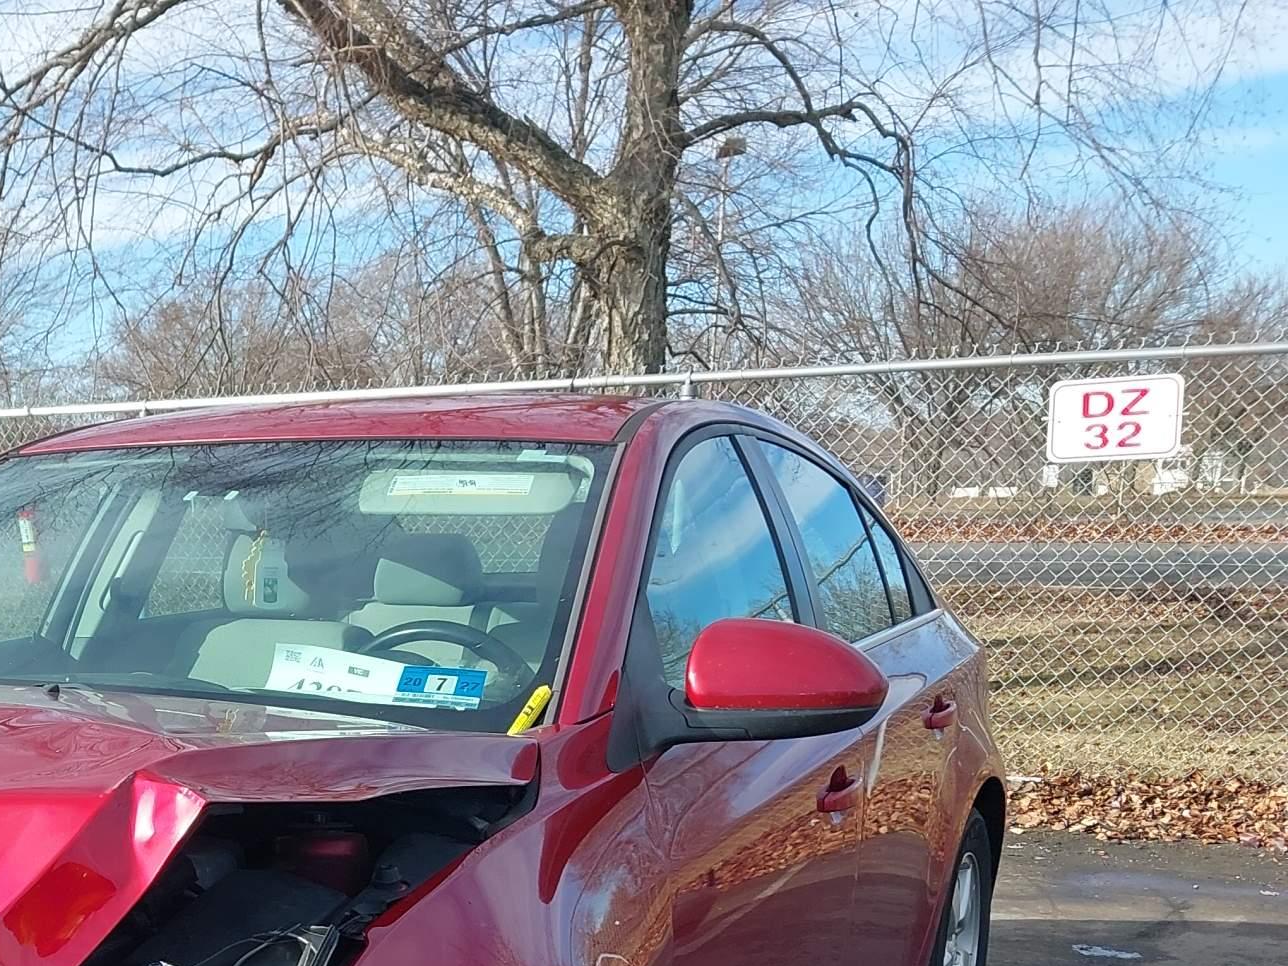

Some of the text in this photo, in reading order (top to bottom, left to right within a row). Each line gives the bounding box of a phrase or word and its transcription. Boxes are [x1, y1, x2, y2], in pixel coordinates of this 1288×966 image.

[1081, 388, 1149, 418] DZ
[1084, 421, 1141, 450] 32
[404, 677, 481, 691] 20 7 27
